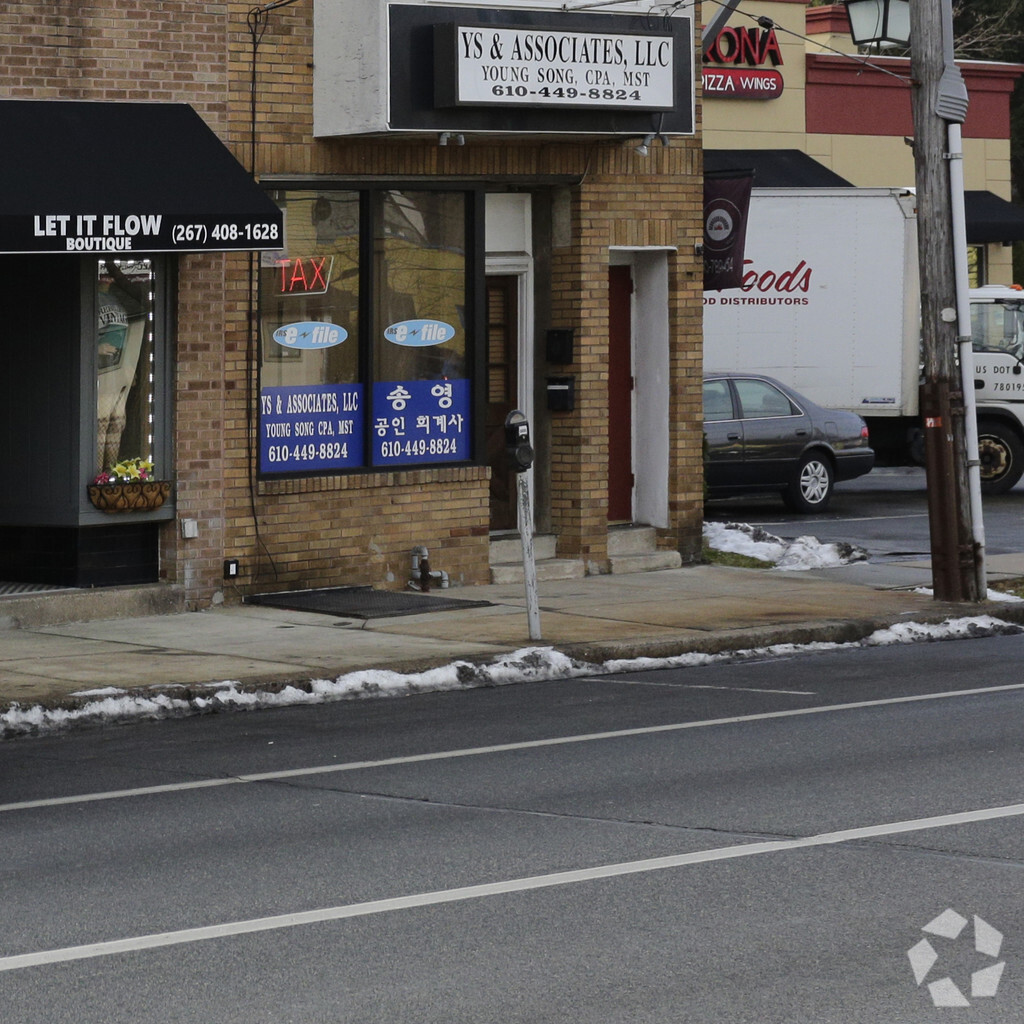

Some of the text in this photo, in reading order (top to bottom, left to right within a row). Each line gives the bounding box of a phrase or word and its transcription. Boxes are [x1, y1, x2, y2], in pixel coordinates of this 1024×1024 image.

[461, 32, 670, 69] YS & ASSOCIATES, LLC
[702, 26, 784, 66] ONA
[481, 65, 650, 87] YOUNG SONG, CPA, MST
[739, 77, 777, 91] WINGS
[491, 85, 642, 101] 610-449-8824
[33, 214, 163, 237] LET IT FLOW
[171, 223, 279, 245] (267) 408-1628
[66, 237, 132, 251] BOUTIQUE
[275, 257, 326, 292] TAX
[720, 297, 809, 306] DISTRIBUTORS
[976, 365, 1010, 374] US DOT
[261, 392, 358, 414] YS & ASSOCIATES, LLC
[386, 382, 453, 411] 송 영
[266, 420, 354, 438] YOUNG SONG CPA, MST
[374, 416, 405, 437] 공인
[268, 443, 348, 462] 610-449-8824
[381, 438, 457, 458] 610-449-8824
